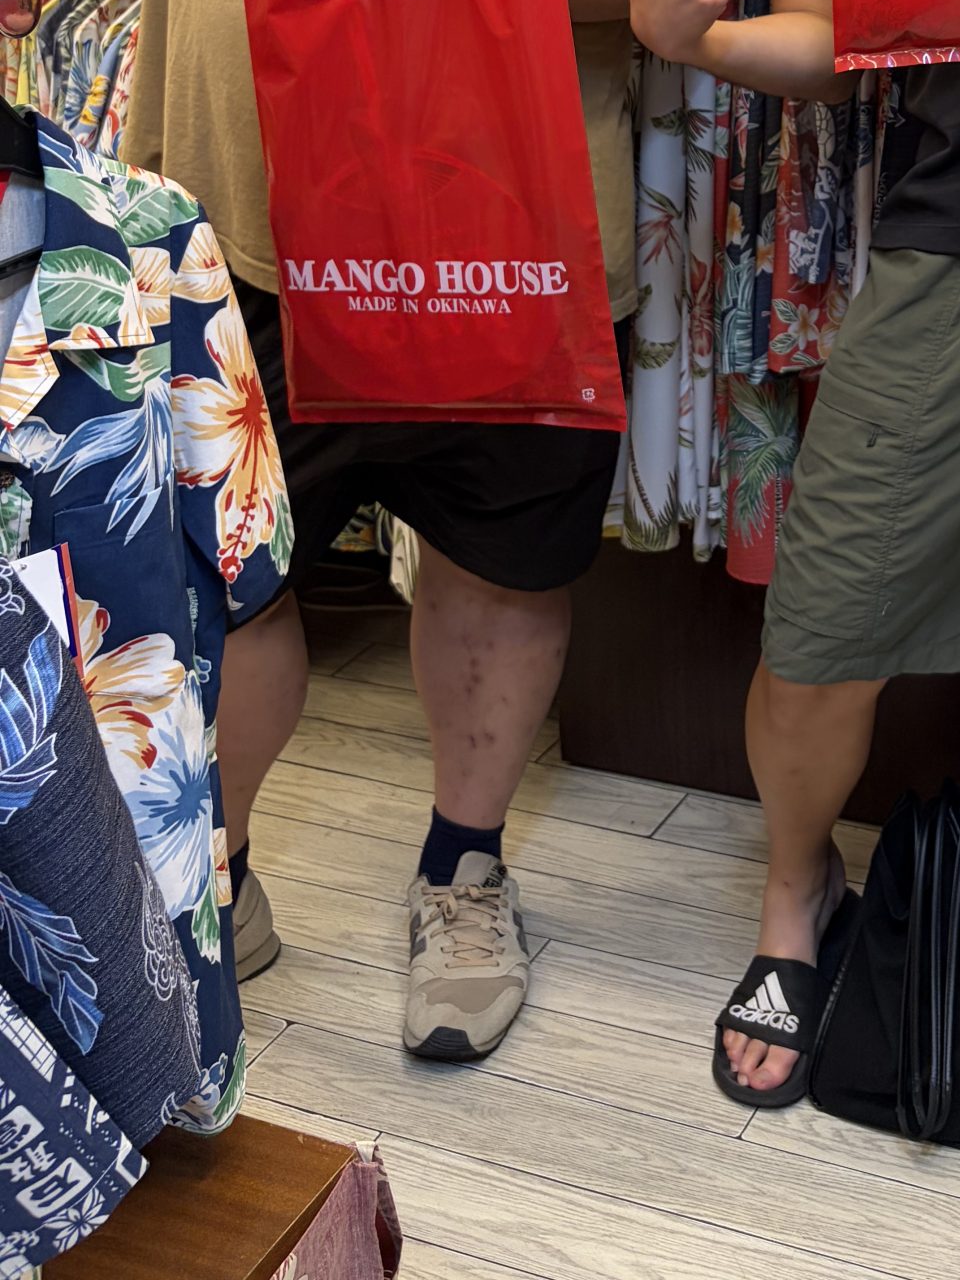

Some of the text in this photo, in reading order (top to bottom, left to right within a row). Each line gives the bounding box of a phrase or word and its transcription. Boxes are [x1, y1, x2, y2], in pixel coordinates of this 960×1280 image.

[284, 258, 569, 296] MANGO HOUSE
[348, 295, 512, 315] MADE IN OKINAWA
[727, 1001, 800, 1034] adidas
